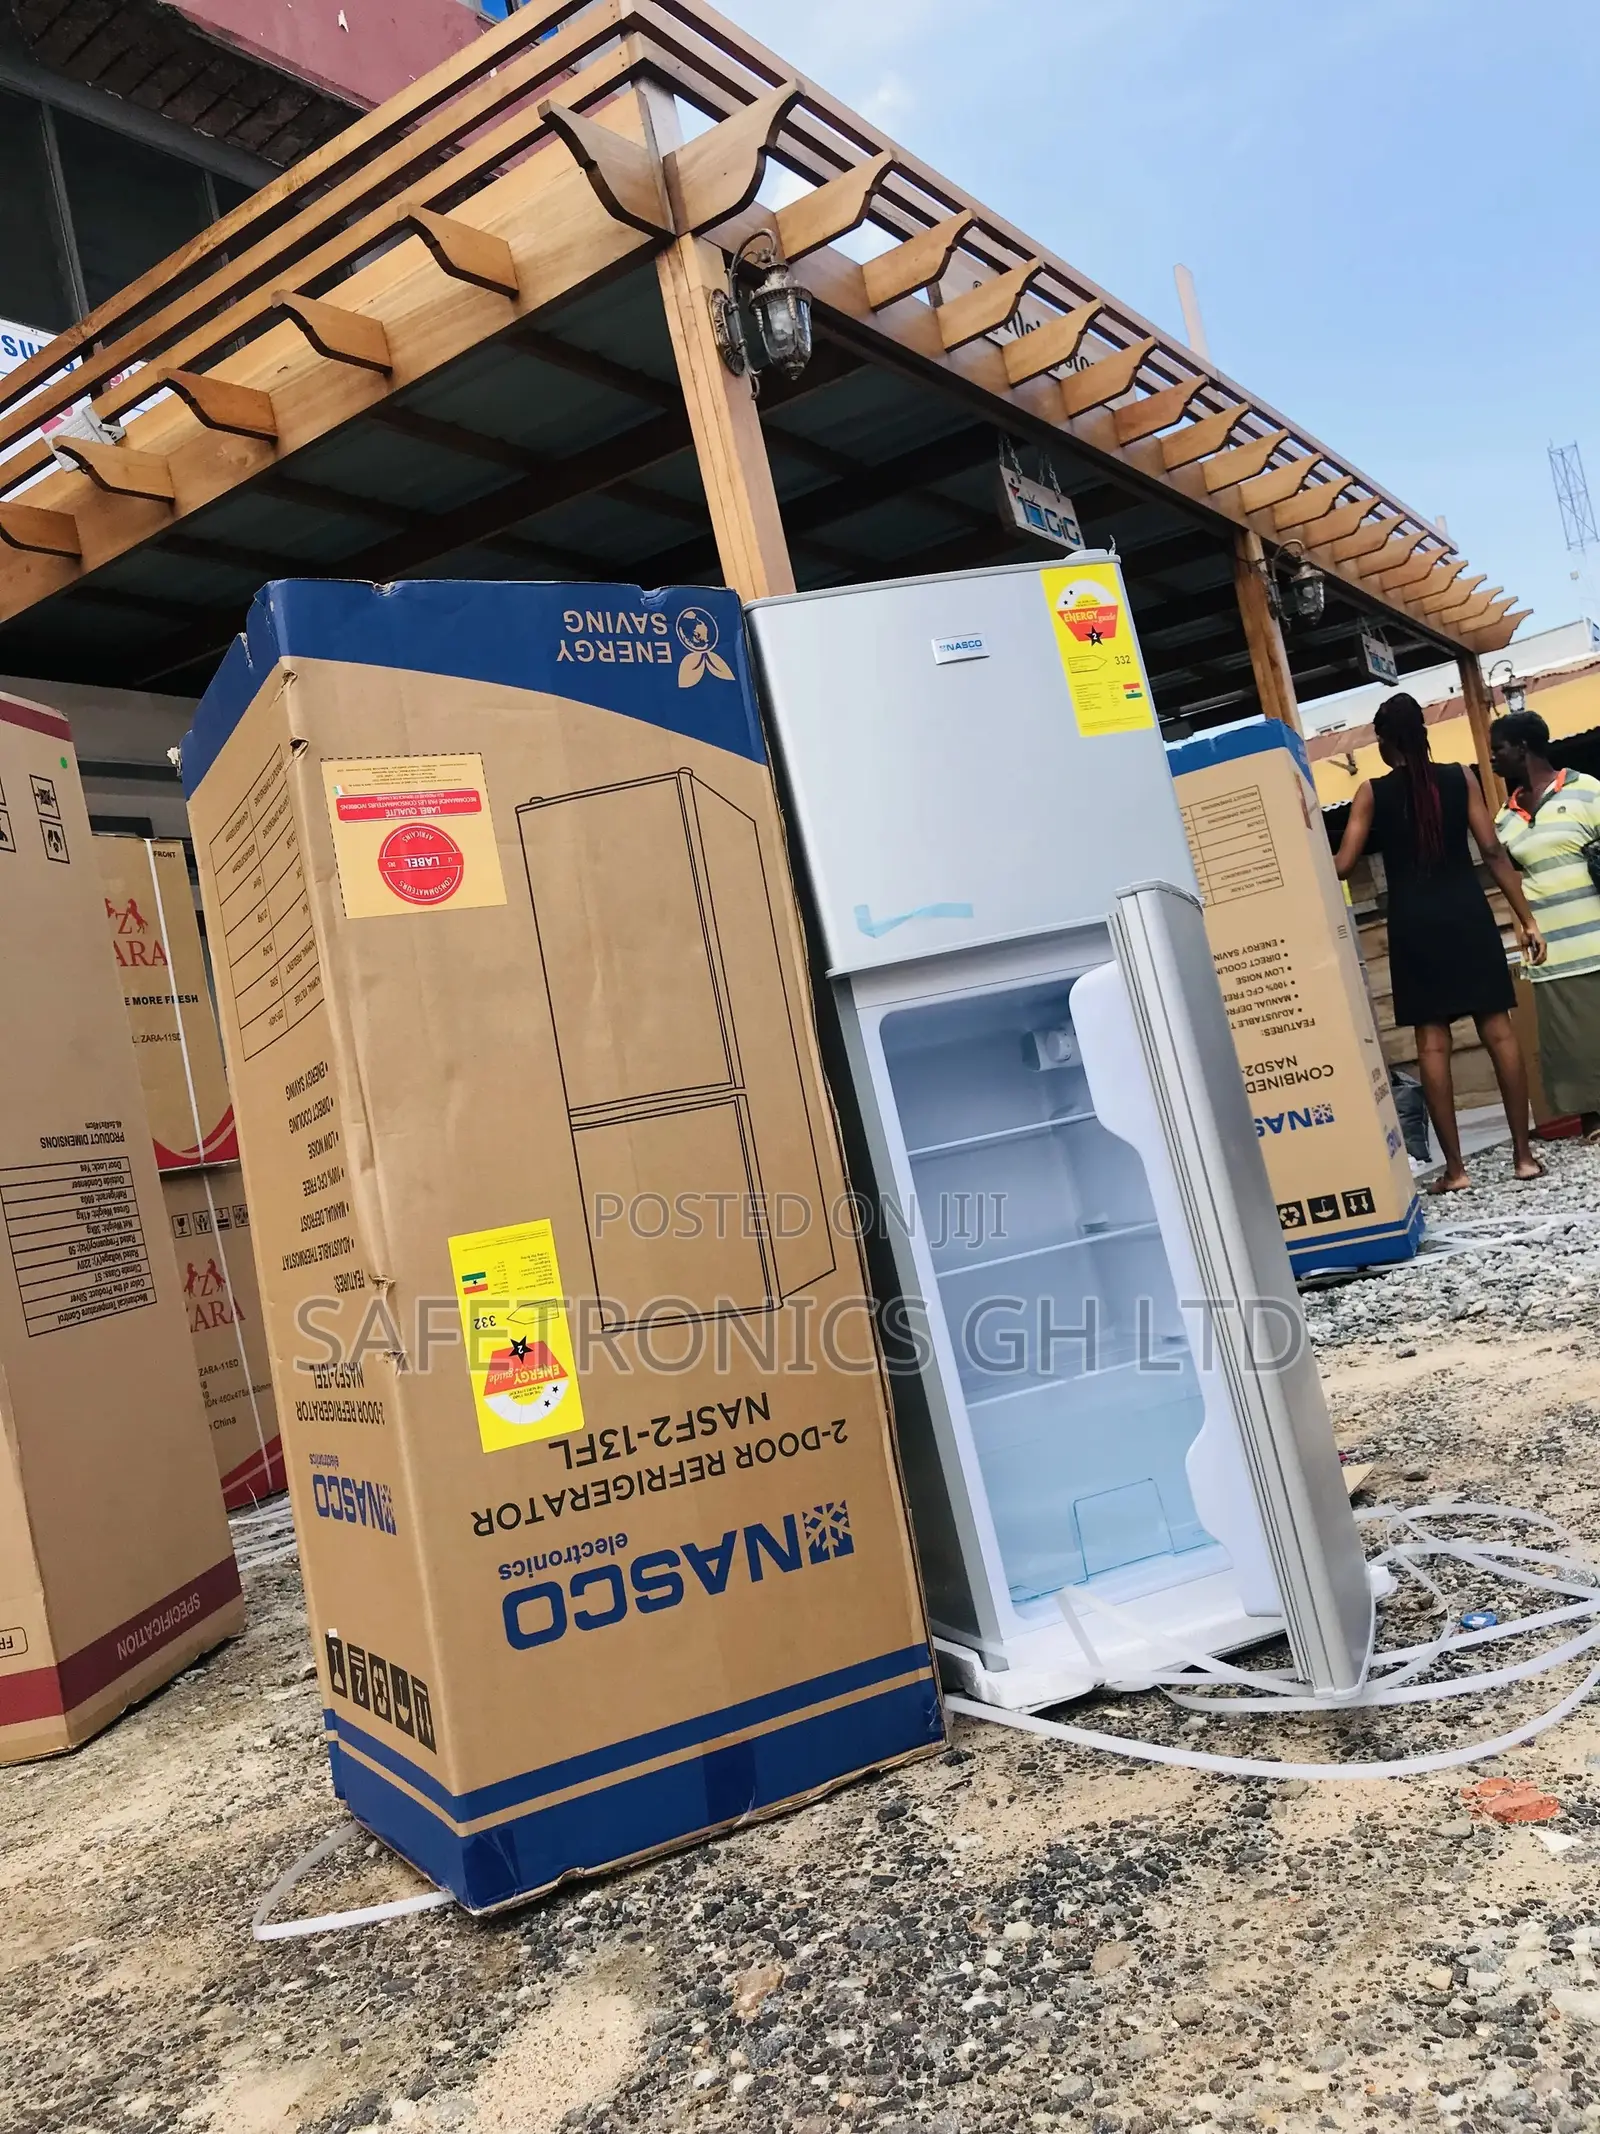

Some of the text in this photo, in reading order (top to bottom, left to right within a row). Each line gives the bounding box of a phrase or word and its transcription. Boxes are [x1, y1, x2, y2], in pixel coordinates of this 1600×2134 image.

[563, 610, 668, 635] SAVING
[1063, 609, 1099, 624] ENERGY
[1092, 632, 1098, 641] 2
[556, 640, 672, 664] ENERGY
[946, 640, 983, 651] NASCO
[1114, 655, 1131, 665] 332
[384, 806, 441, 818] LABEL QUALITÉ
[401, 830, 434, 843] AFRICAINS
[153, 850, 176, 858] FRONT
[404, 856, 440, 868] LABEL
[398, 877, 453, 896] CONSOMMATEURS
[1241, 939, 1278, 955] ENERGY
[1249, 952, 1281, 967] DIRECT
[1235, 966, 1285, 986] LOW NOISE
[1246, 986, 1264, 997] CFC
[1265, 980, 1288, 992] 100%
[132, 996, 163, 1006] MORE
[1254, 994, 1292, 1008] MANUAL
[1237, 1008, 1295, 1028] ADJUSTABLE
[1260, 1018, 1316, 1037] FEATURES:
[1241, 1055, 1298, 1077] NASD2-
[285, 1061, 326, 1101] ENERGY SAVING
[1244, 1064, 1334, 1094] COMBINED
[288, 1096, 331, 1134] DIRECT COOLING
[39, 1132, 125, 1149] PRODUCT DIMENSIONS
[307, 1131, 336, 1160] LOW NOISE
[80, 1164, 91, 1173] Yes
[108, 1161, 122, 1170] Door
[71, 1175, 125, 1189] Outside Condenser
[302, 1176, 317, 1197] FREE
[113, 1205, 130, 1214] Gross
[300, 1201, 347, 1232] MANUAL DEFROST
[122, 1220, 133, 1230] Net
[119, 1234, 136, 1244] Rated
[68, 1246, 76, 1255] 50
[122, 1249, 139, 1259] Rated
[282, 1236, 351, 1271] ADJUSTABLE THERMOSTAT
[77, 1260, 91, 1271] 220V
[94, 1264, 142, 1282] Climate Class: ST
[113, 1283, 122, 1292] the
[122, 1282, 129, 1290] of
[130, 1278, 145, 1289] Color
[333, 1269, 365, 1294] FEATURES:
[70, 1292, 88, 1303] Silver
[57, 1293, 148, 1325] Mechanical Temperature Control
[474, 1315, 497, 1330] 332
[517, 1345, 524, 1355] 2
[309, 1362, 365, 1389] NASF2-13FL
[487, 1363, 560, 1385] ENERGY guide
[295, 1400, 357, 1424] REFRIGERATOR
[213, 1416, 237, 1430] China
[548, 1392, 771, 1470] NASF2-13FL
[470, 1419, 849, 1537] 2-DOOR REFRIGERATOR
[312, 1474, 385, 1531] NASCO
[497, 1533, 628, 1581] electronics
[501, 1514, 803, 1651] NASCO
[117, 1593, 200, 1660] SPECIFICATION
